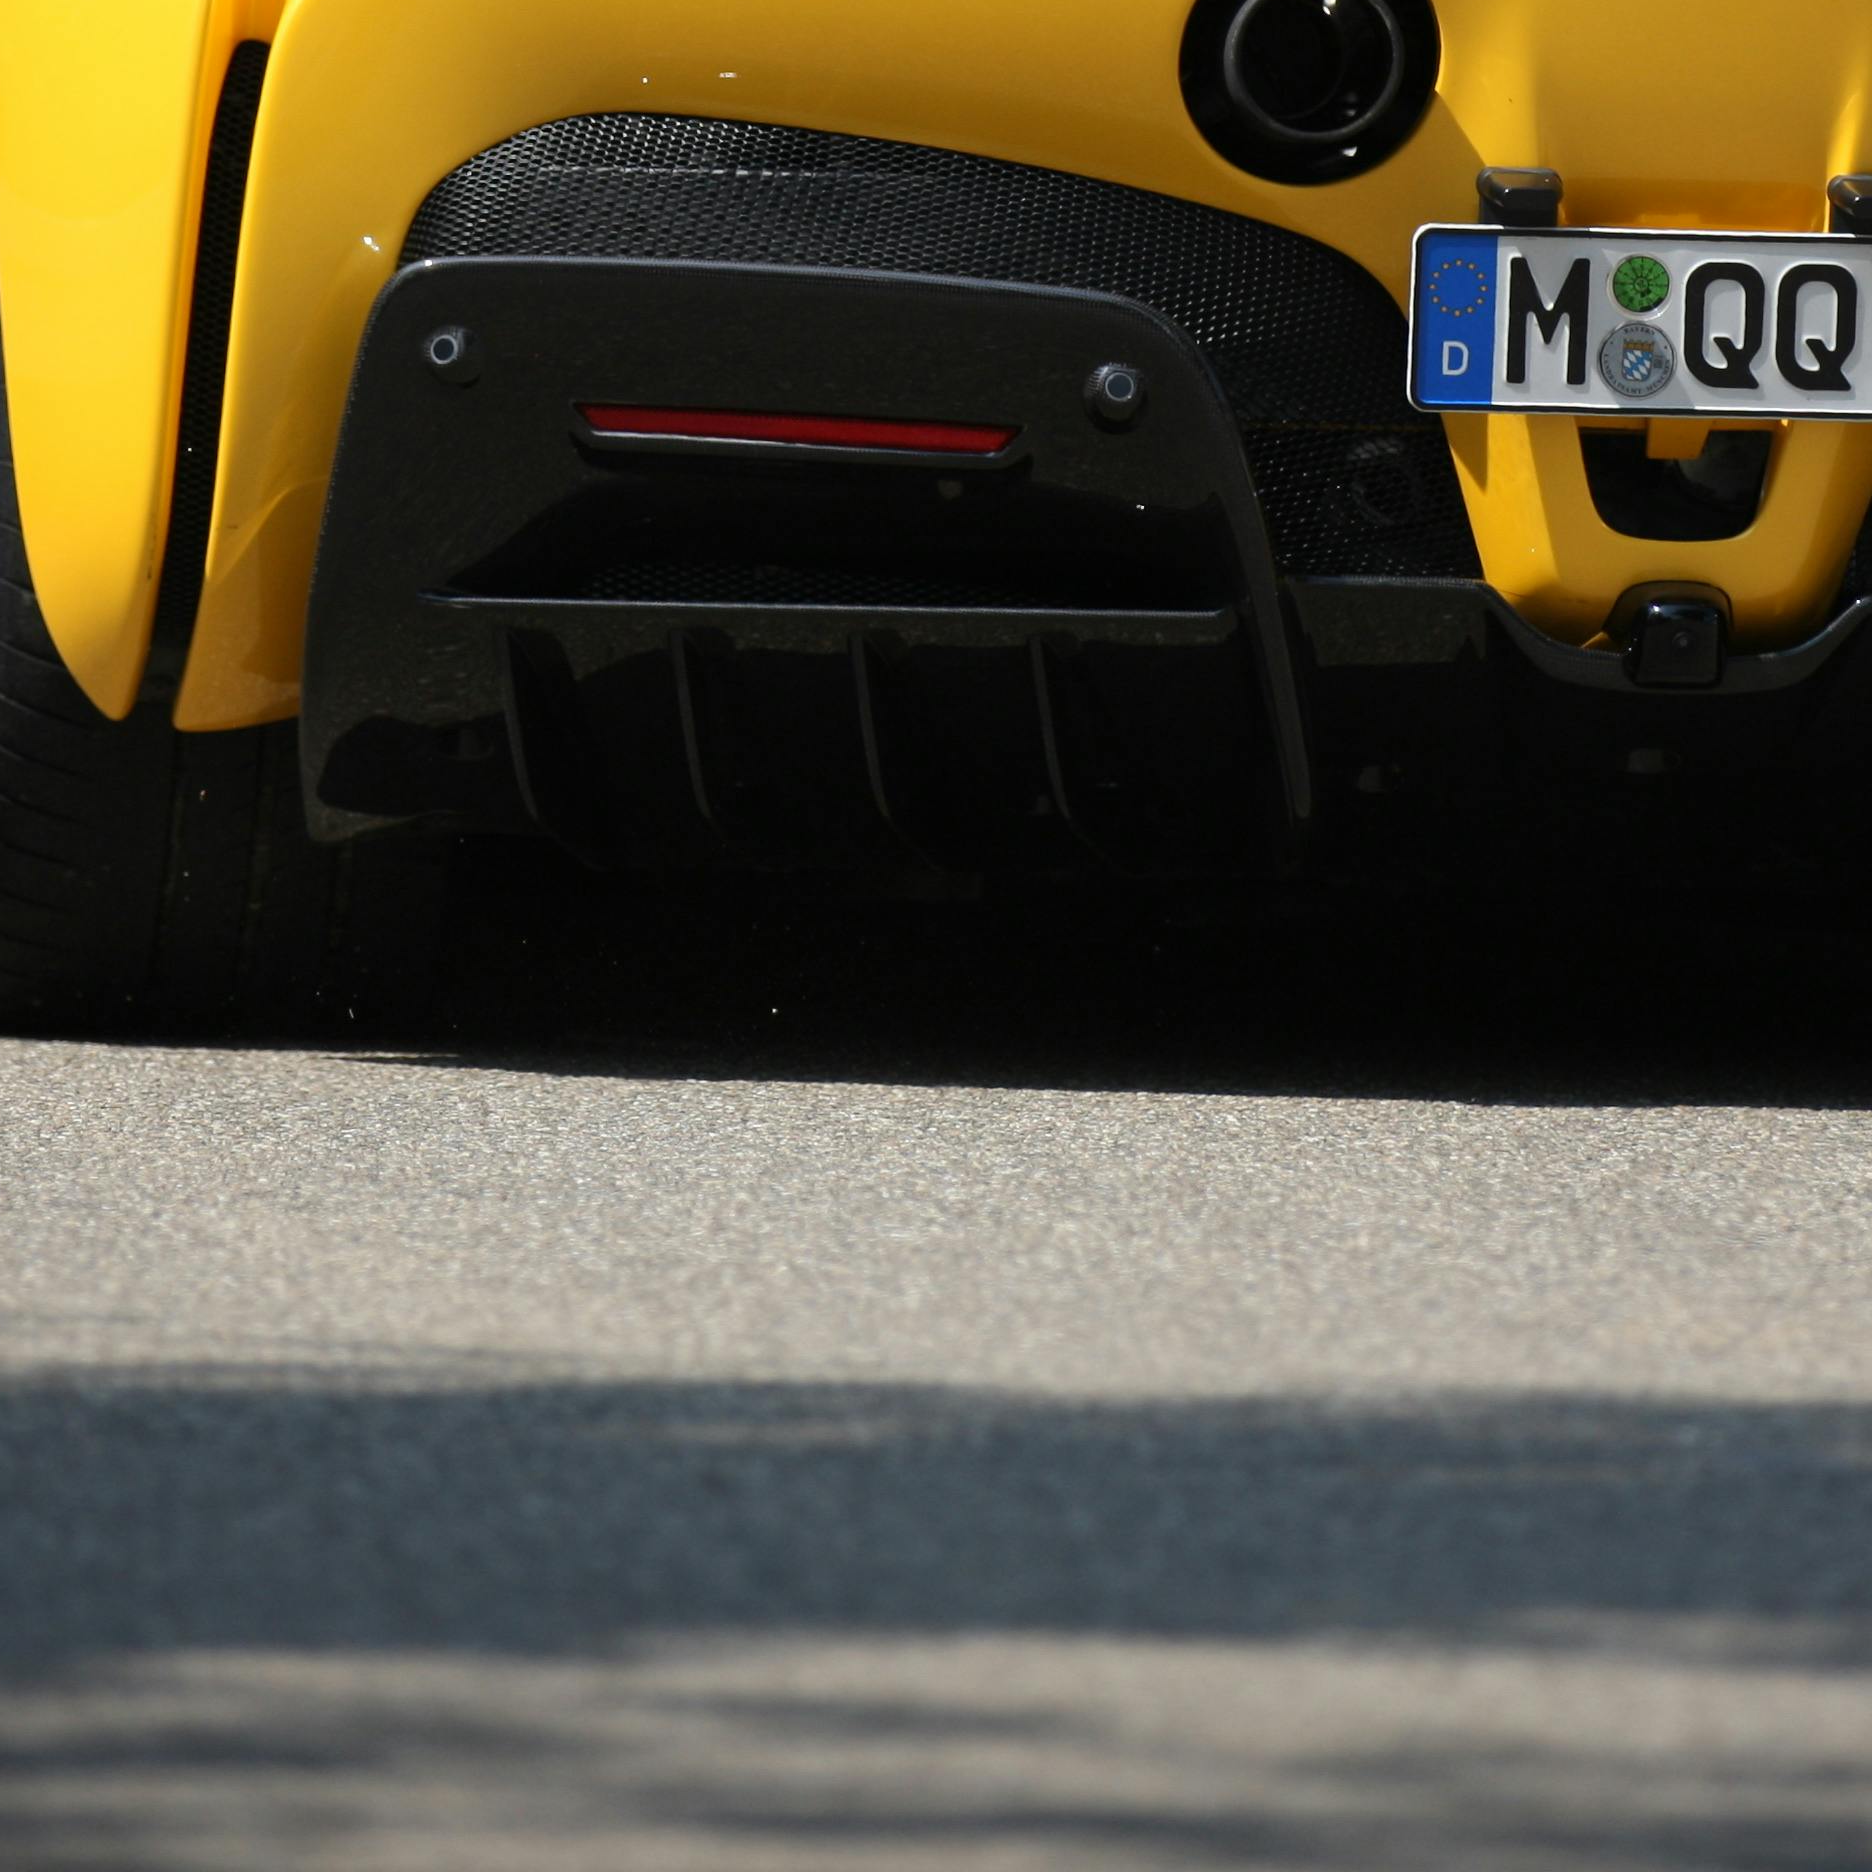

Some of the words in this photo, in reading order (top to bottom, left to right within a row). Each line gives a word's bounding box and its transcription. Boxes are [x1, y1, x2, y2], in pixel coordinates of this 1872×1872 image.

[1441, 340, 1470, 377] D
[1506, 257, 1591, 385] M
[1684, 261, 1858, 392] QQ
